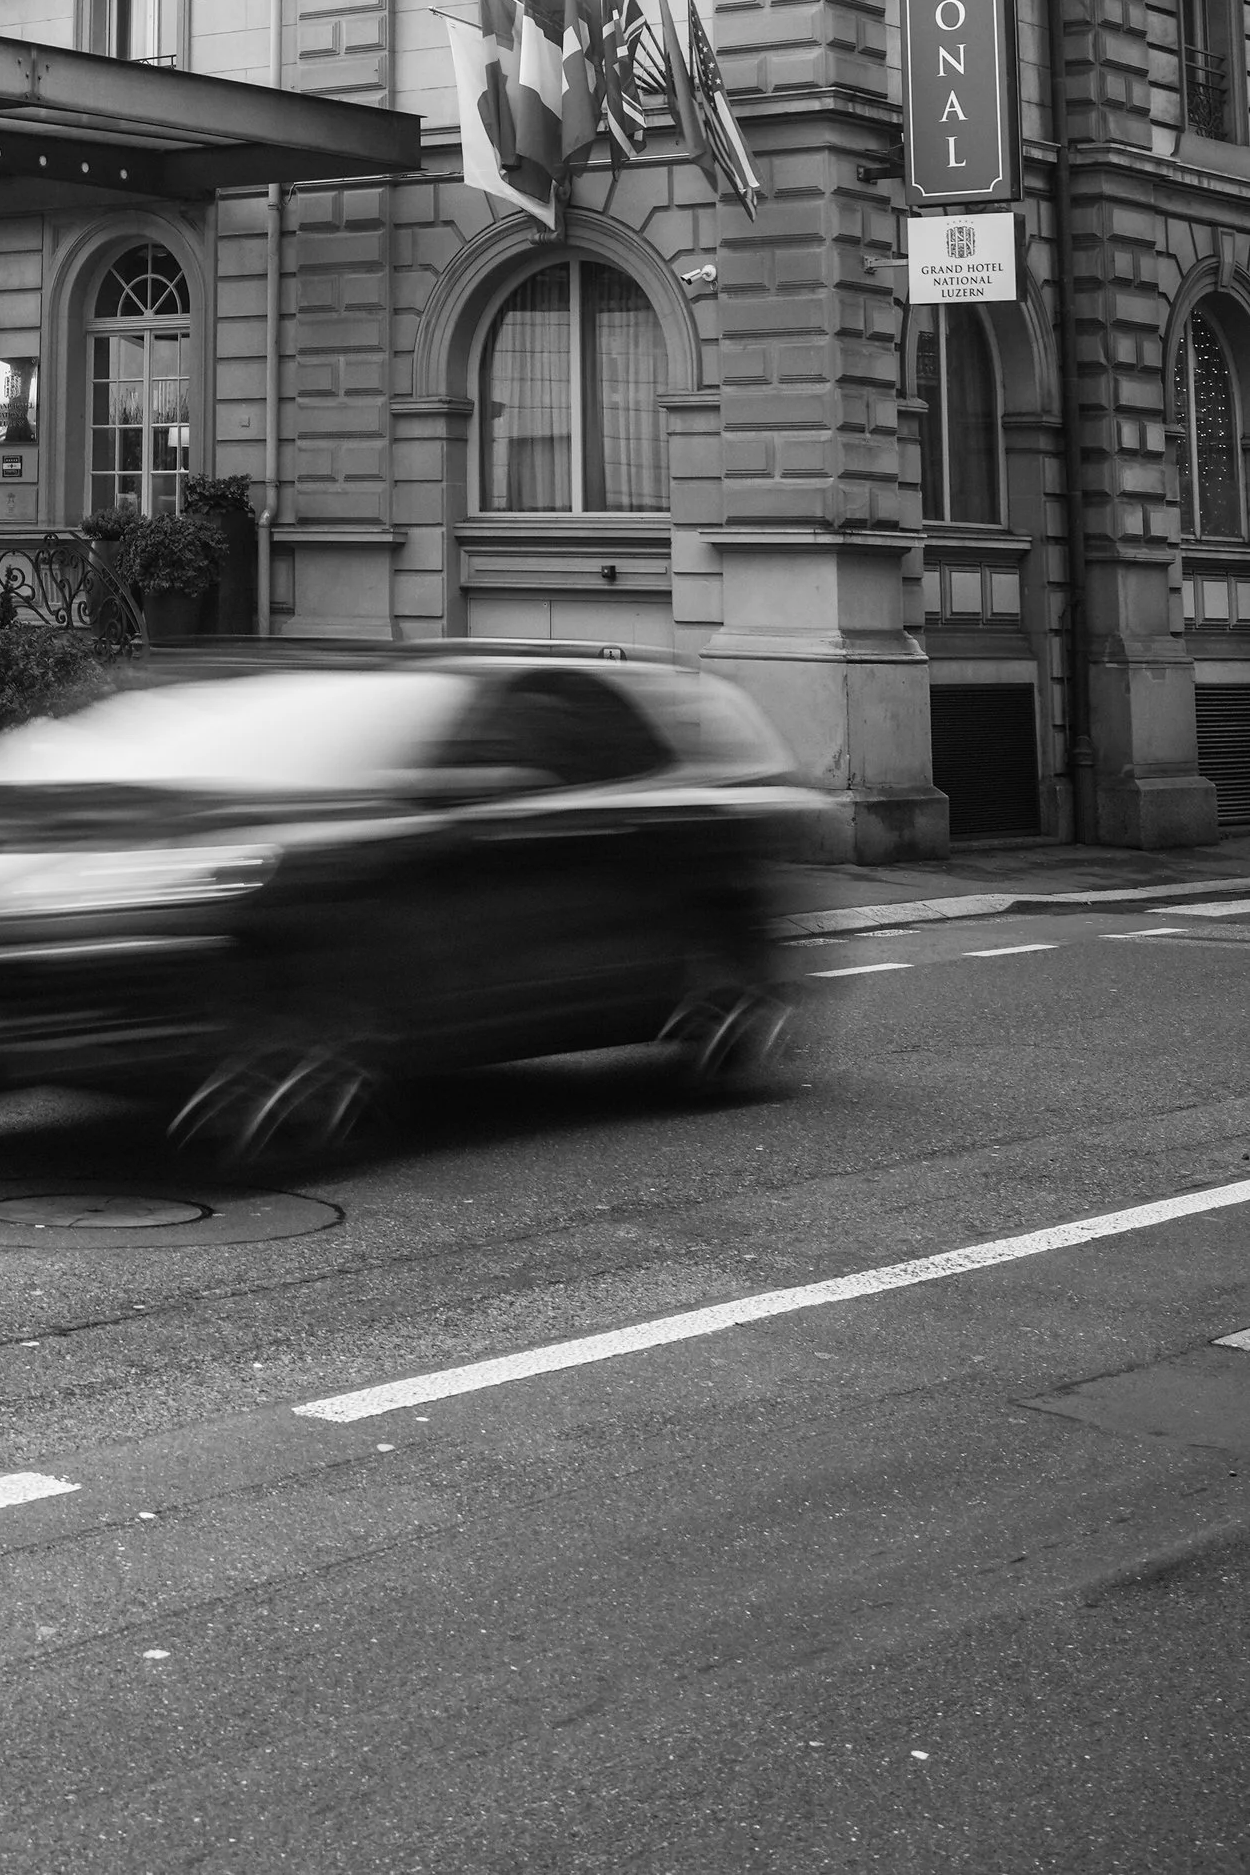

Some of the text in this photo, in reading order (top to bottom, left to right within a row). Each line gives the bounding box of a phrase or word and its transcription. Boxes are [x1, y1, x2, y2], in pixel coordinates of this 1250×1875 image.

[921, 262, 1004, 275] GRAND HOTEL
[933, 275, 993, 286] NATIONAL
[941, 287, 984, 298] LUZERN
